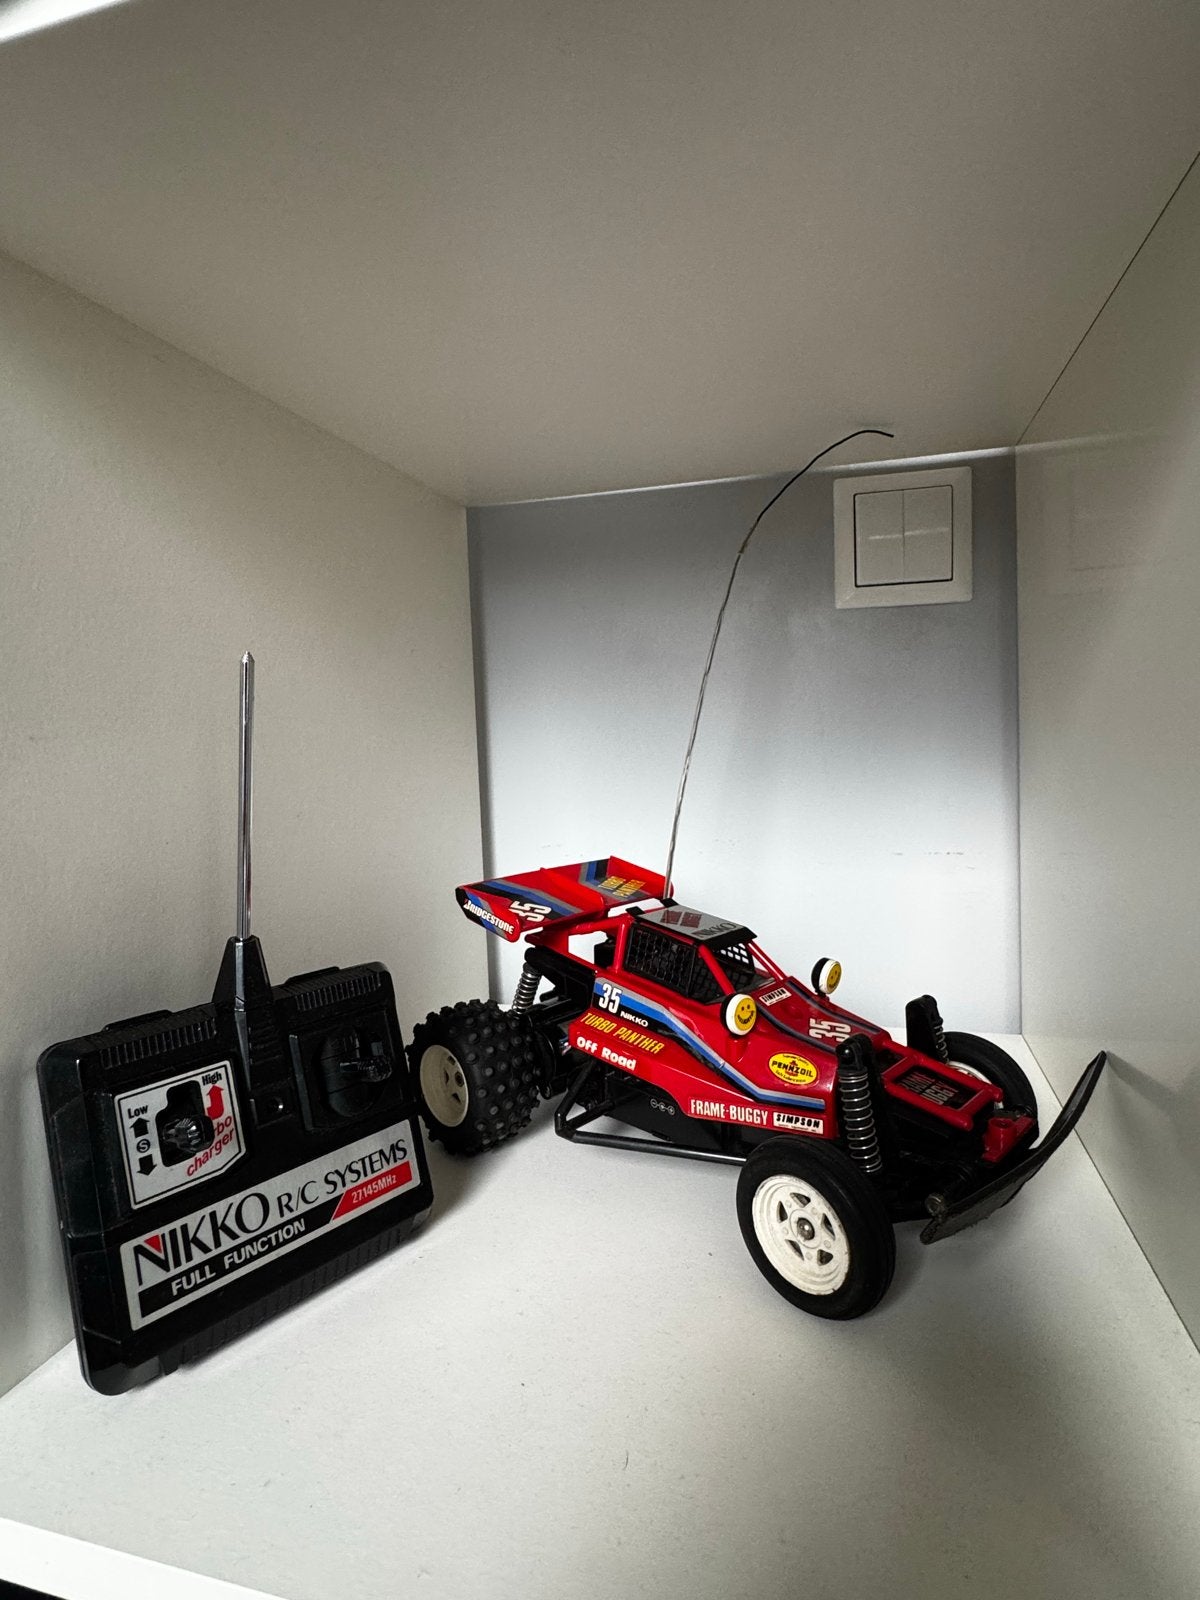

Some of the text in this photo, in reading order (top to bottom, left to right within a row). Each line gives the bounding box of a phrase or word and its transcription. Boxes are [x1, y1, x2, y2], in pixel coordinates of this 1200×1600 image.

[463, 899, 515, 935] BRIDGESTONE
[598, 983, 623, 1014] 35
[620, 1010, 649, 1028] NIKKO
[808, 1017, 851, 1043] 35
[580, 1012, 665, 1055] TURBO PANTHER
[601, 1046, 637, 1071] Road
[771, 1060, 815, 1078] PENNZOIL
[201, 1071, 223, 1086] High
[127, 1104, 150, 1120] Low
[690, 1099, 769, 1126] FRAME-BUGGY
[776, 1113, 820, 1128] SIMPSON
[186, 1128, 235, 1177] charger
[133, 1138, 408, 1287] NIKKO R/C SYSTEMS
[171, 1217, 306, 1296] FULL FUNCTION
